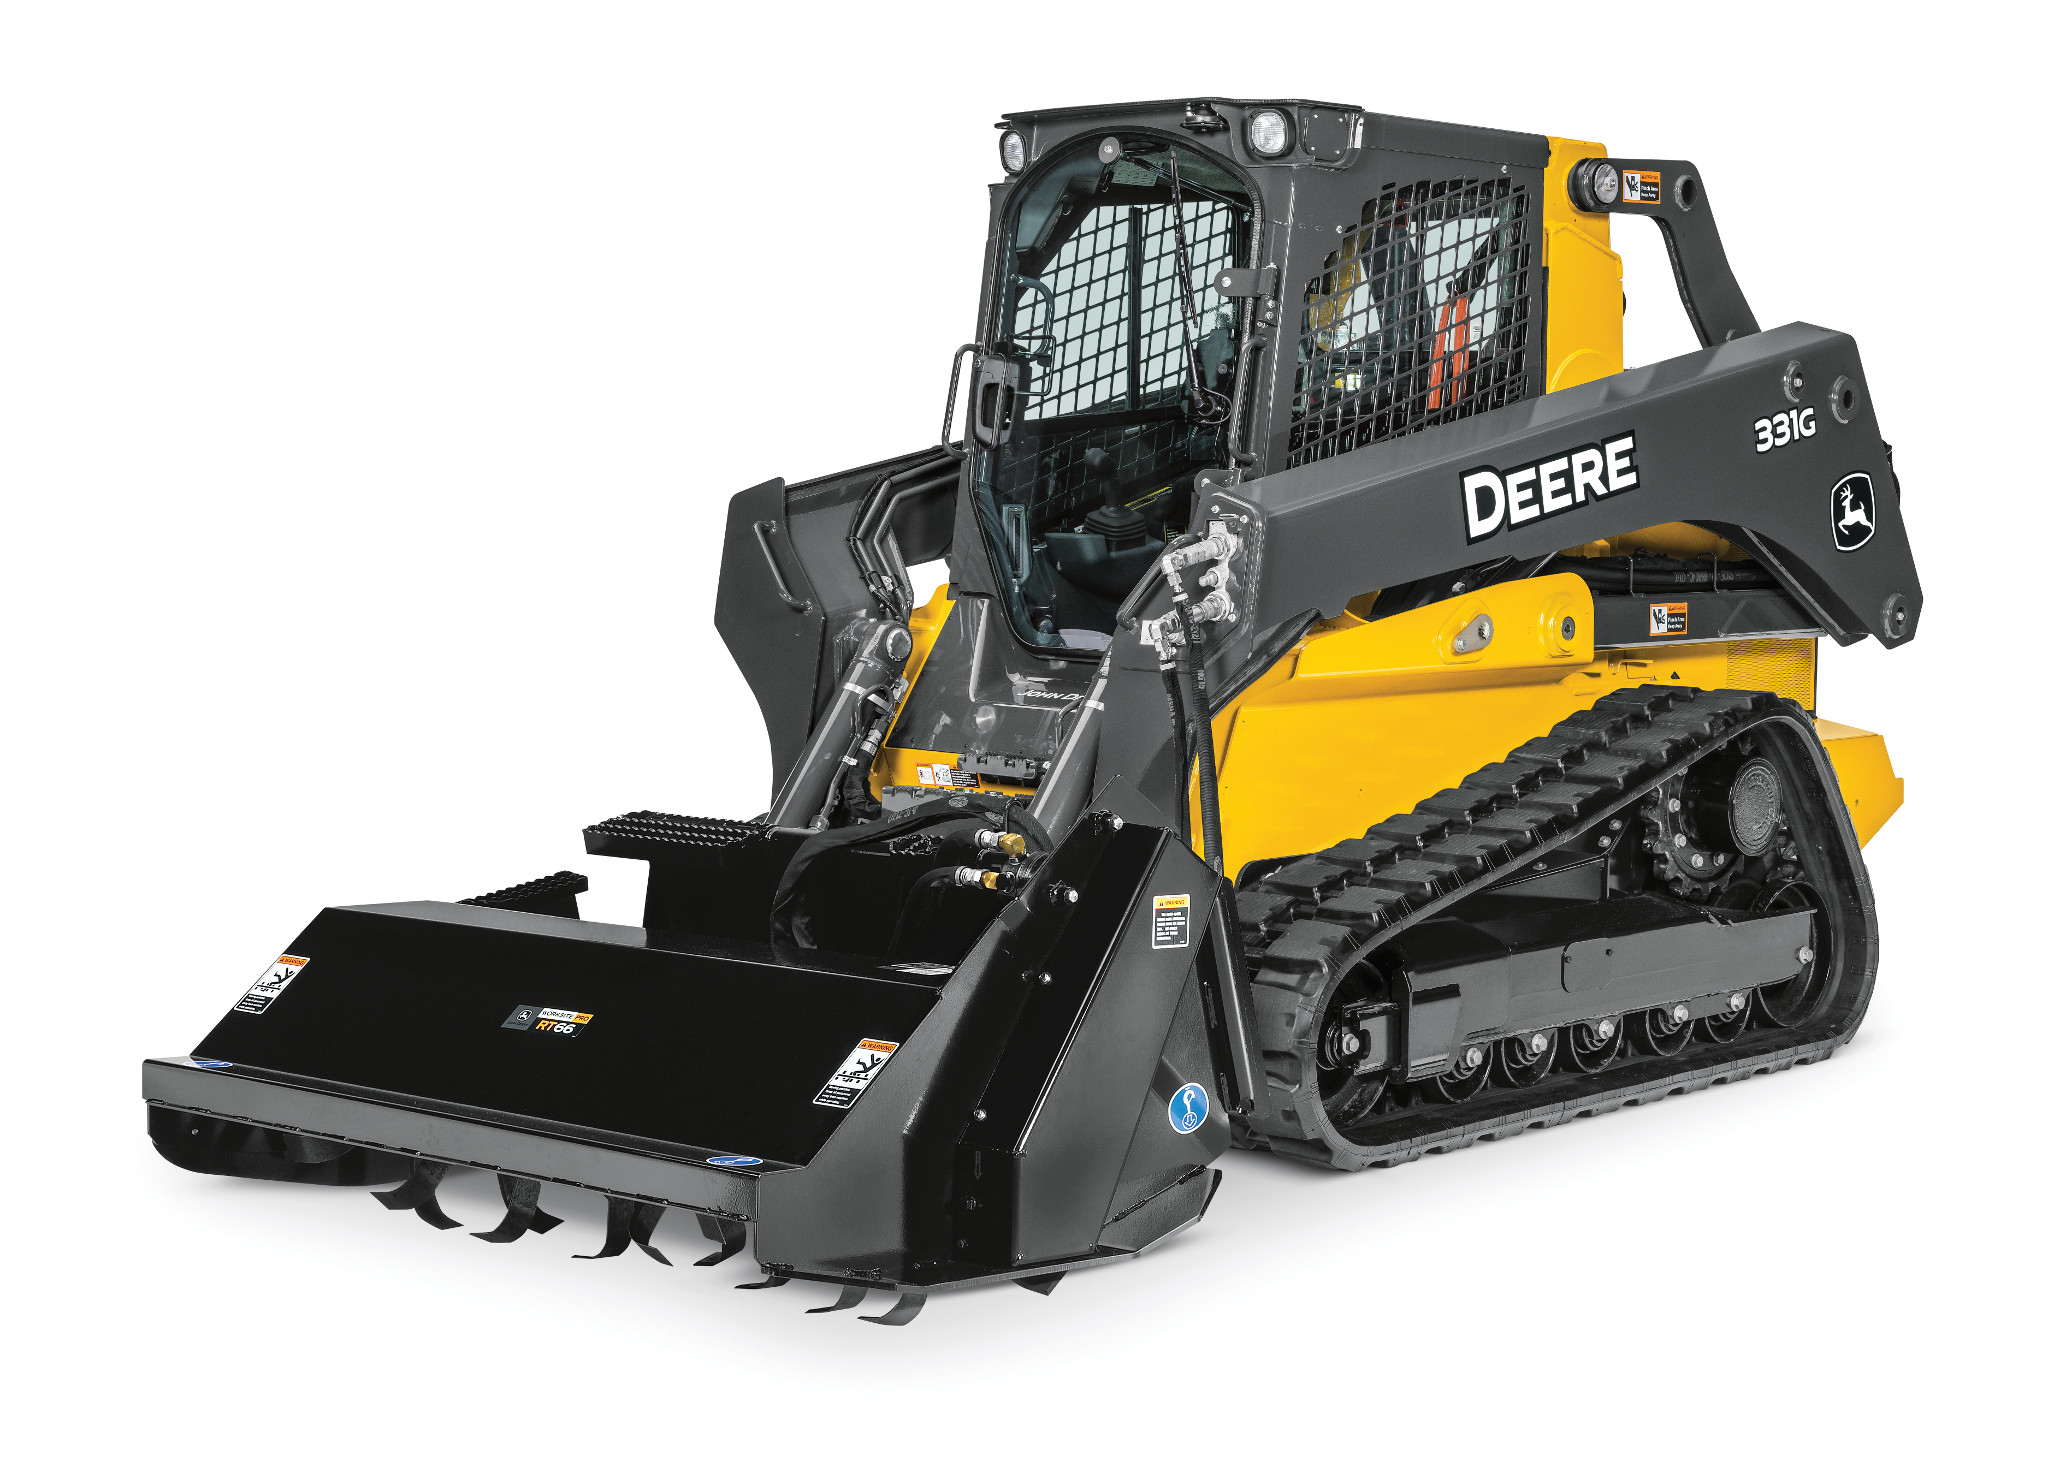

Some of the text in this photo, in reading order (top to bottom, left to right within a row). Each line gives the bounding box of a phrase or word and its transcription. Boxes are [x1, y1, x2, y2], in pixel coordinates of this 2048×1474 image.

[1754, 407, 1817, 452] 331G
[1463, 435, 1638, 539] DEERE
[1016, 689, 1064, 699] JOHN
[541, 1010, 590, 1022] WORKSITE PRO
[535, 1019, 577, 1034] RT66
